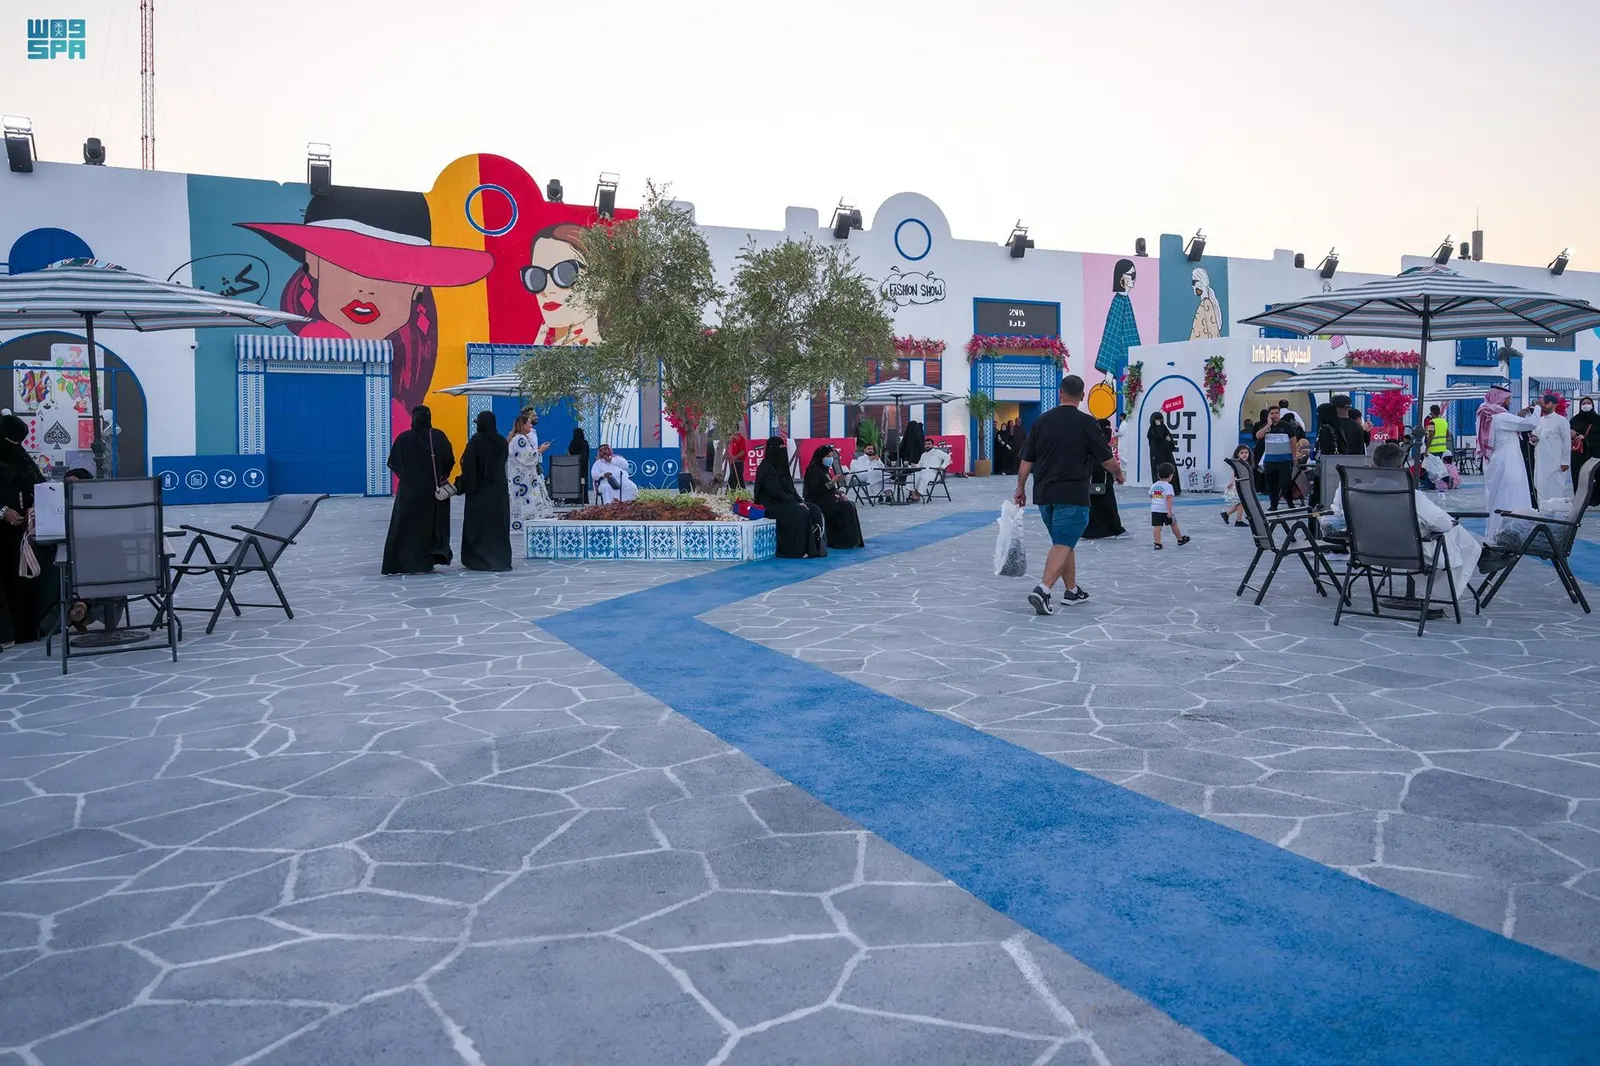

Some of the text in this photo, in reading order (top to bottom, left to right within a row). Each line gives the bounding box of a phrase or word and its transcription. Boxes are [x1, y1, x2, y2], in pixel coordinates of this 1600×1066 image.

[889, 283, 942, 298] FASHION SHOW
[1252, 344, 1282, 363] Info Desk
[747, 449, 765, 459] OU
